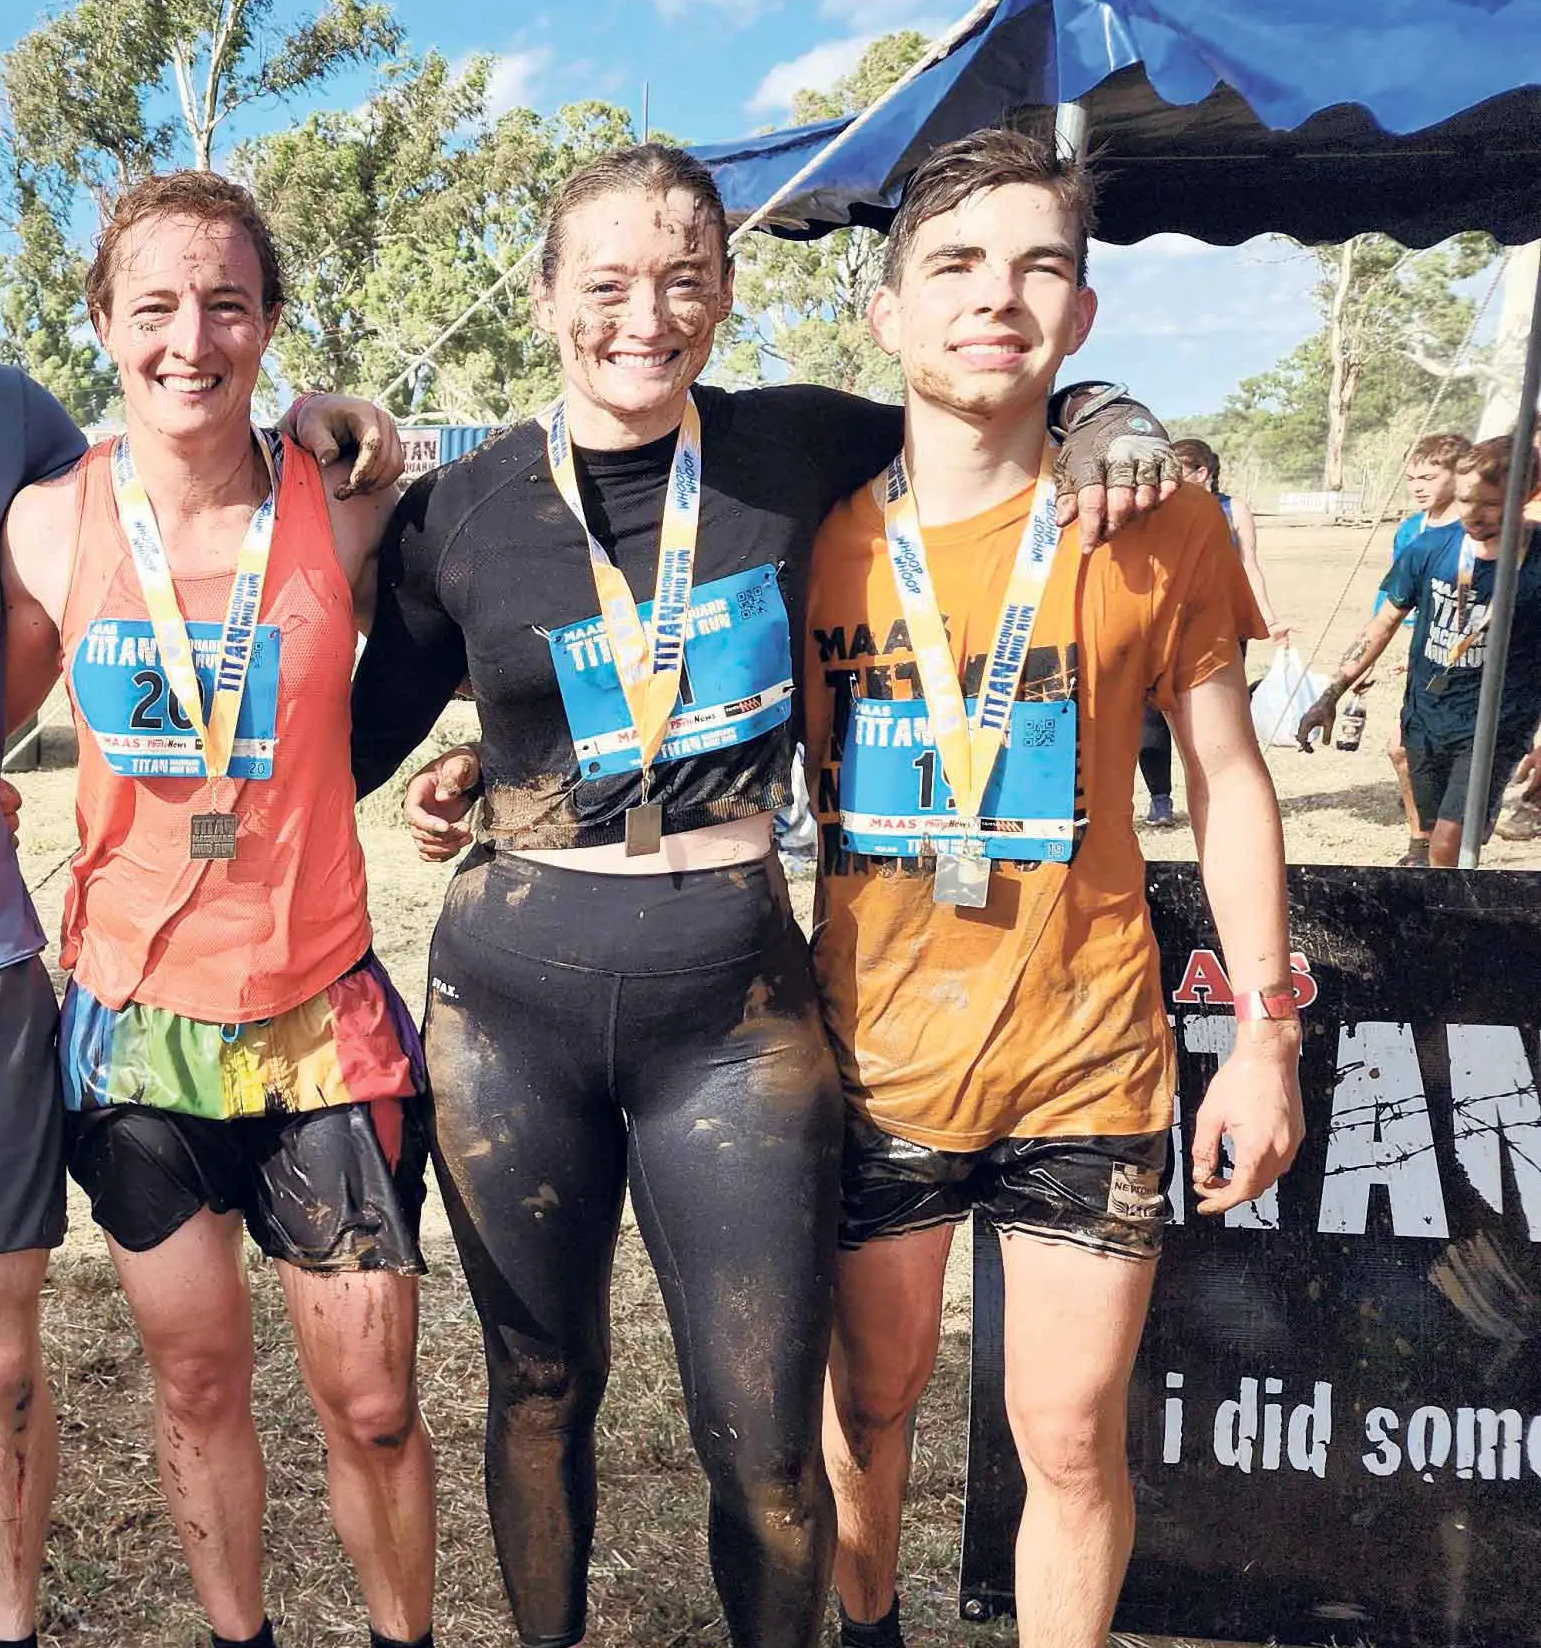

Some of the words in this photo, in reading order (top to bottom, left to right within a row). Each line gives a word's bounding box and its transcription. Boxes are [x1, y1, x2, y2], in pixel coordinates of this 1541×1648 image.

[677, 465, 690, 511] WHOOP
[685, 451, 699, 494] WHOOP
[896, 535, 923, 575] WHOOP
[1033, 515, 1047, 562] WHOOP
[246, 574, 260, 598] RUN
[893, 556, 922, 594] WHOOP
[229, 573, 249, 625] MACQUARIE
[239, 601, 257, 627] MUD
[86, 635, 159, 667] TITAN
[653, 606, 685, 674] TITAN
[995, 604, 1019, 651] MACQUARIE
[1008, 633, 1028, 669] MUD
[1018, 605, 1034, 632] RUN
[218, 626, 251, 692] TITAN
[129, 669, 205, 730] 20
[981, 659, 1018, 730] TITAN
[250, 763, 265, 774] 20
[913, 750, 957, 811] 1
[870, 818, 917, 829] MAAS
[1162, 1371, 1185, 1464] i
[1213, 1376, 1333, 1479] did
